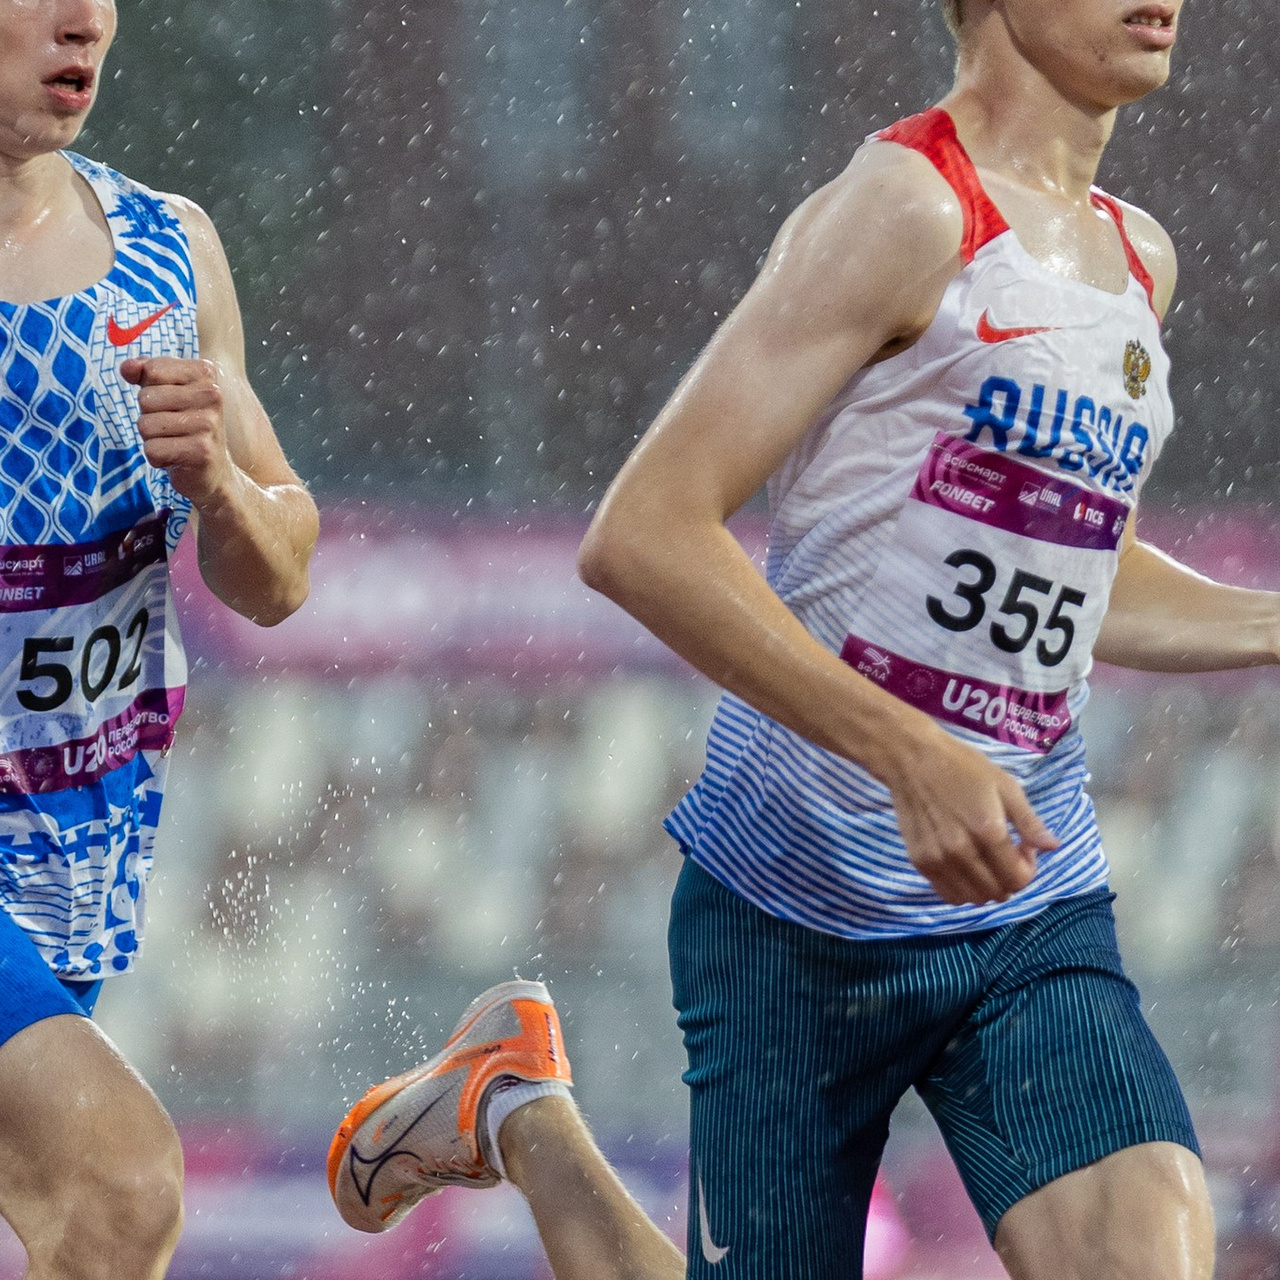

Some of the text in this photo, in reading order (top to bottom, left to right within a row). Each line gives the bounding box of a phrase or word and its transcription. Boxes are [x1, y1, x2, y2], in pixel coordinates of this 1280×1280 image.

[962, 375, 1149, 492] RUSSIA
[929, 479, 995, 512] FONBET
[1040, 488, 1062, 507] URAL
[1084, 507, 1105, 526] ПСБ
[925, 548, 1088, 668] 355
[15, 607, 150, 712] 502
[941, 678, 1007, 726] U20
[1003, 718, 1039, 741] РОССИИ
[63, 734, 108, 776] U20
